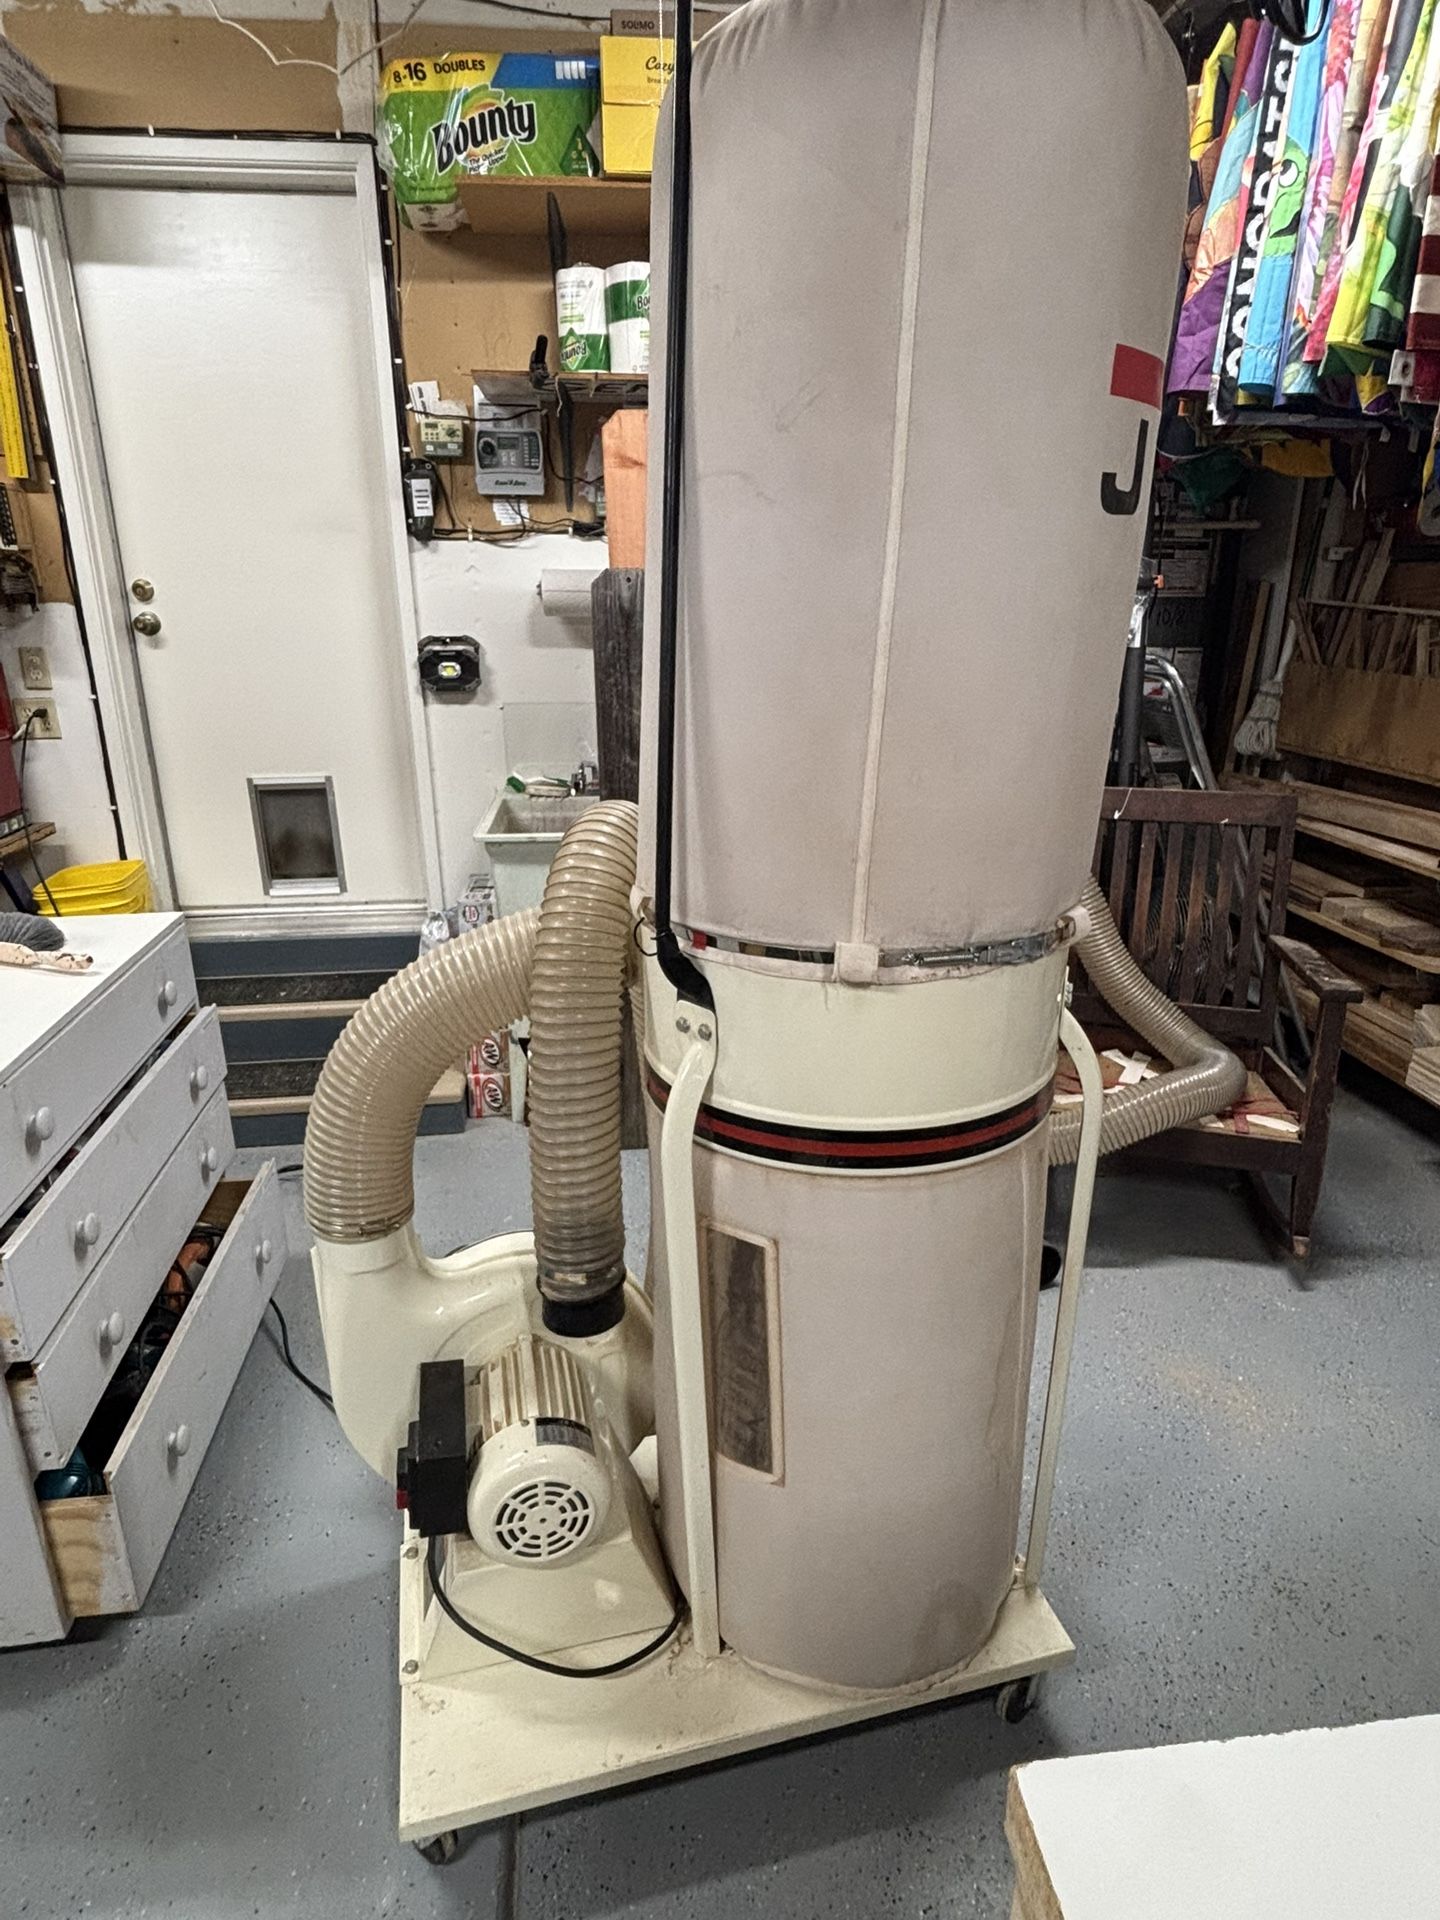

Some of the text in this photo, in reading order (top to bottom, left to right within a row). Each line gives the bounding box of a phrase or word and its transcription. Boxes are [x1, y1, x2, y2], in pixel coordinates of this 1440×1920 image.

[433, 60, 485, 74] DOUBLES
[431, 98, 536, 172] Bounty
[1100, 417, 1149, 515] J
